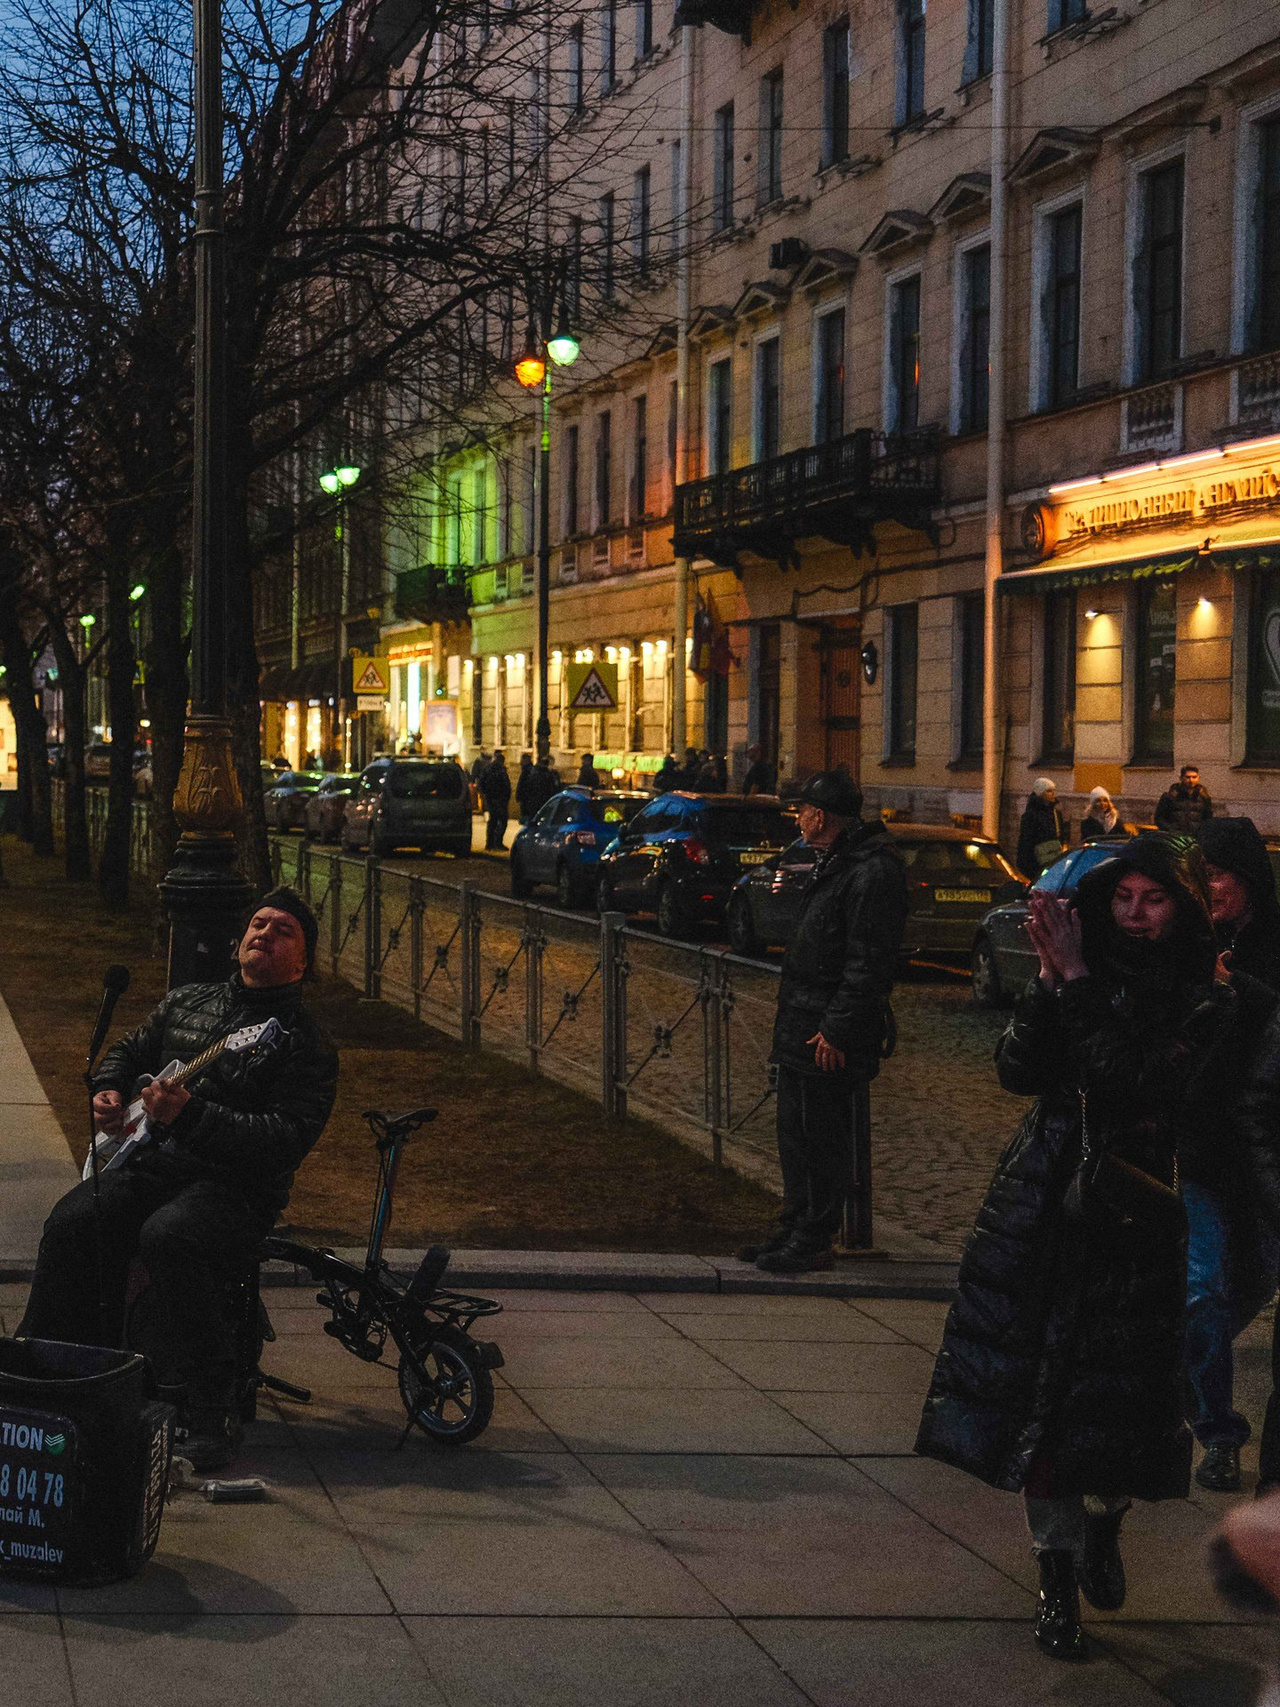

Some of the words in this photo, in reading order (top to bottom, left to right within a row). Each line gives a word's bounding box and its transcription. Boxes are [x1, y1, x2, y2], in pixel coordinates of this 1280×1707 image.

[1194, 467, 1280, 517] АНГЛИЙС
[17, 1466, 38, 1502] 04
[43, 1471, 64, 1508] 78
